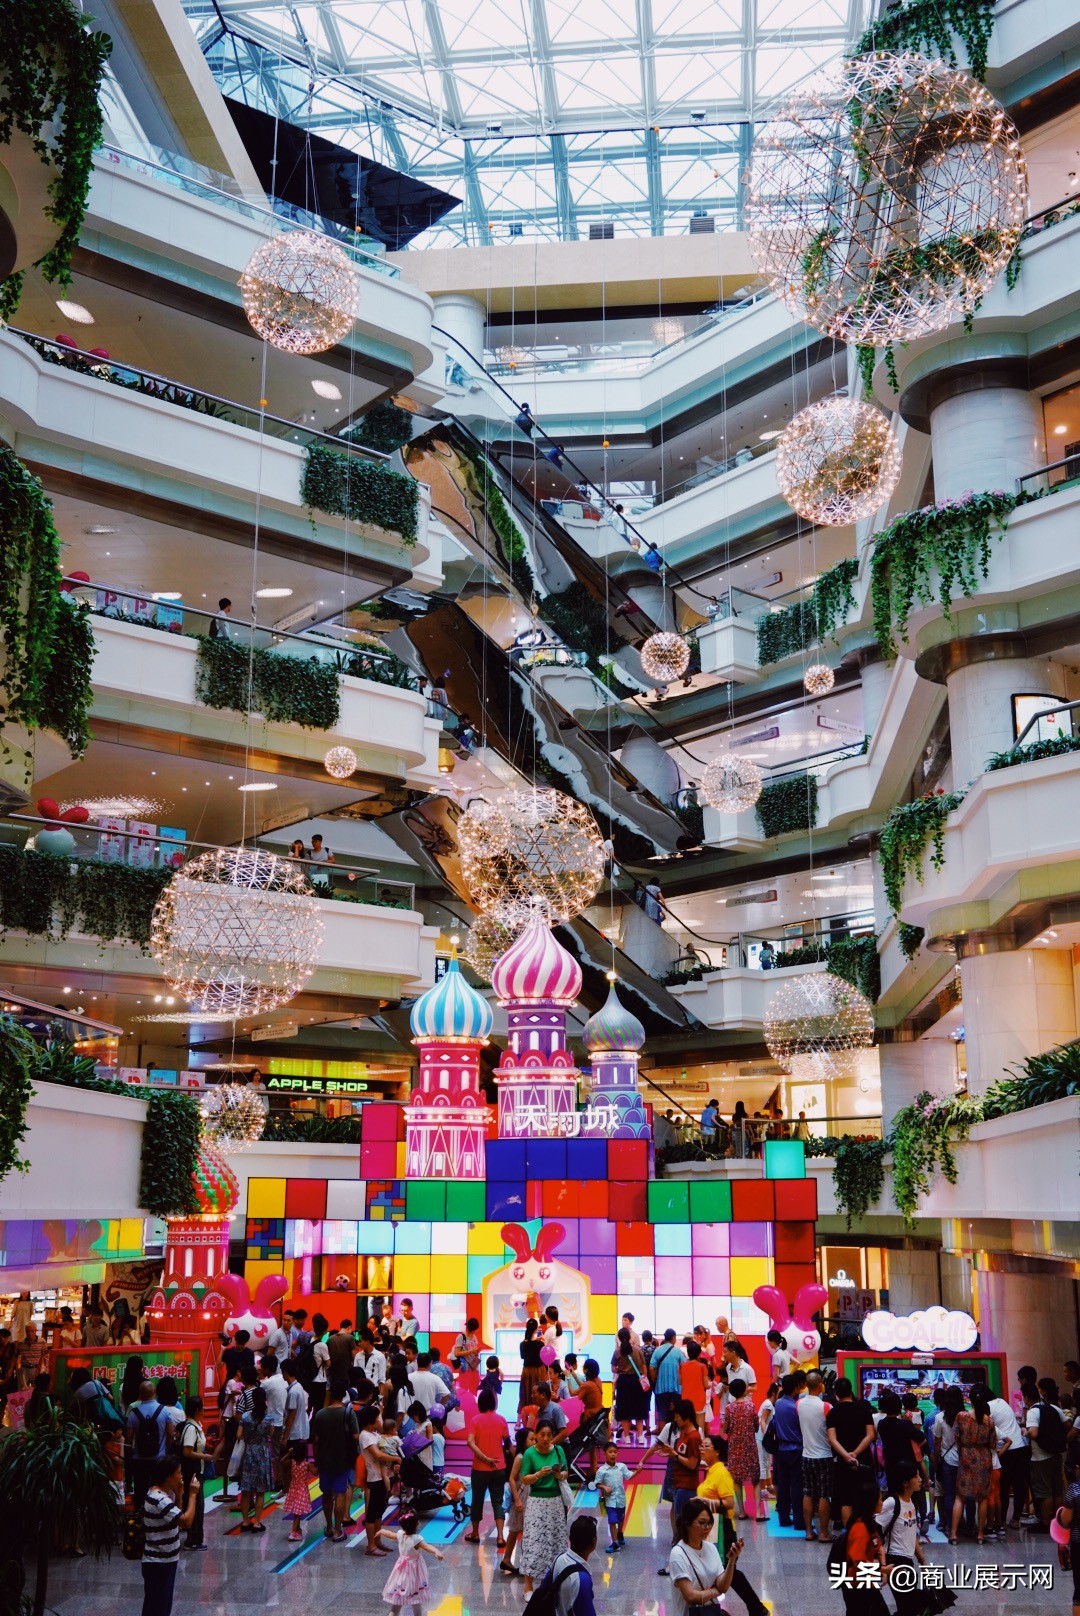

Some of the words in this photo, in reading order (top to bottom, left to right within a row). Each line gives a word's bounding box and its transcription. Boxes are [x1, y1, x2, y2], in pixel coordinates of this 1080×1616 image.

[268, 1078, 322, 1090] APPLE
[326, 1081, 368, 1092] SHOP
[515, 1103, 620, 1137] 天河城
